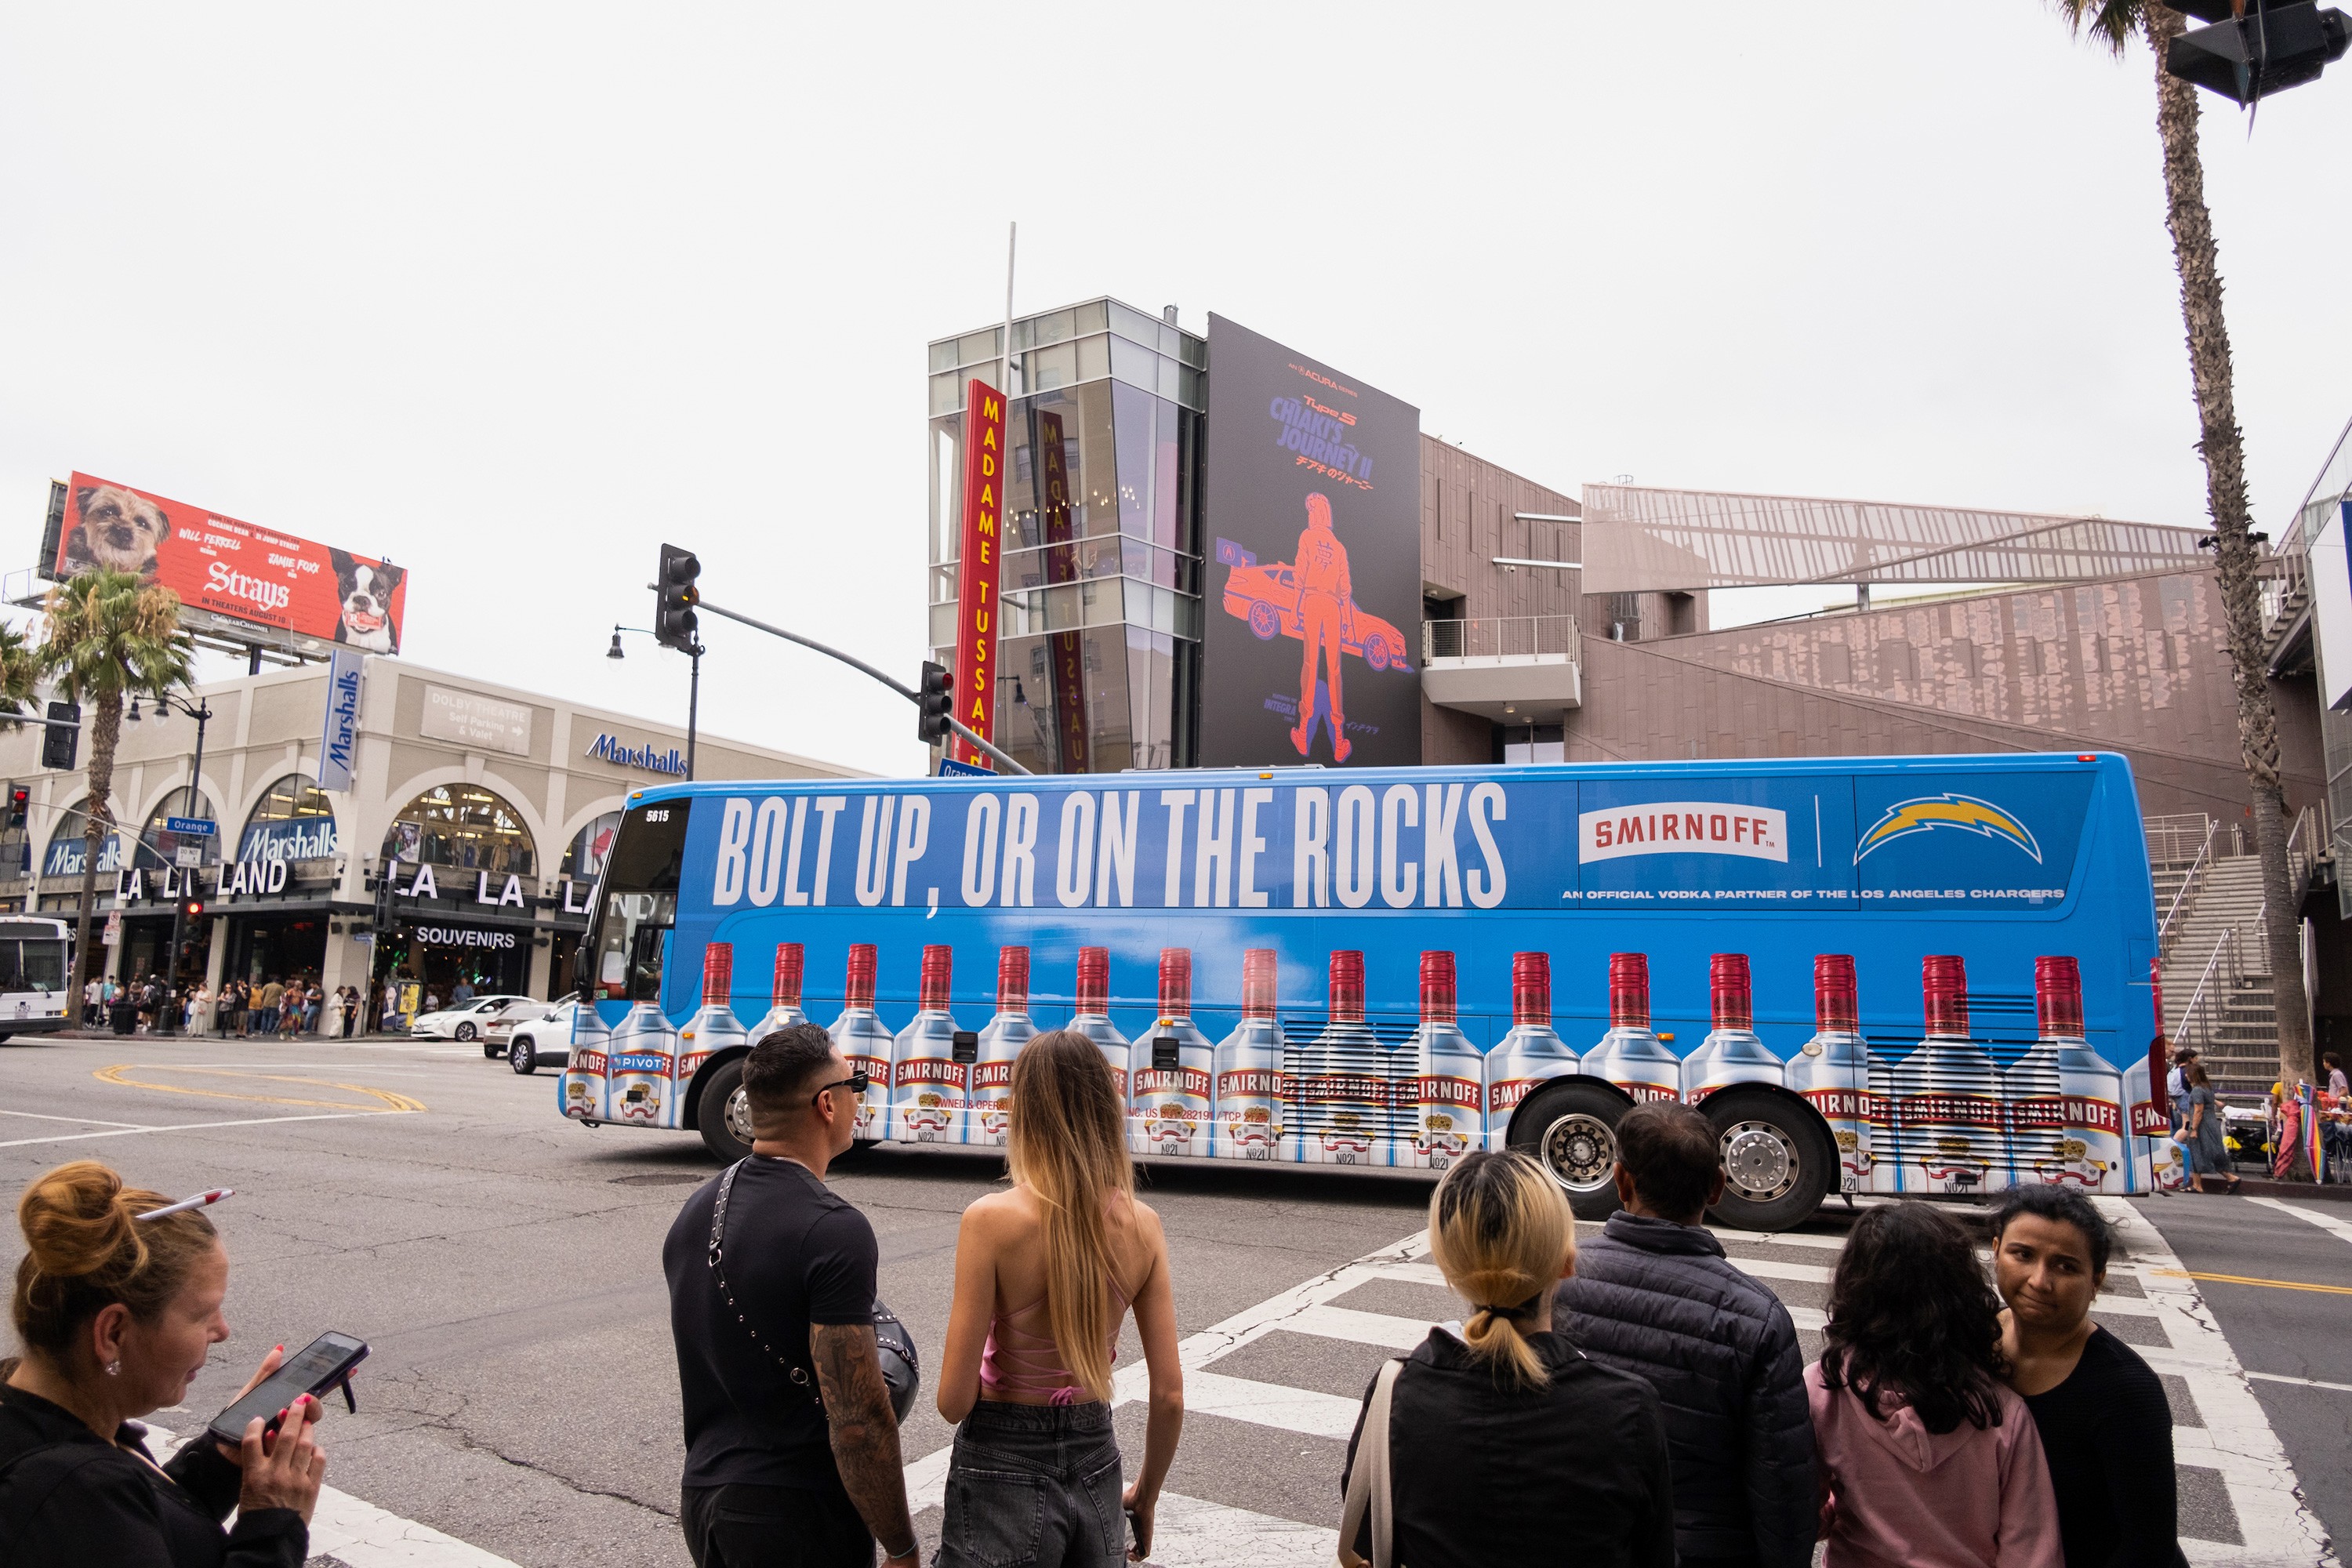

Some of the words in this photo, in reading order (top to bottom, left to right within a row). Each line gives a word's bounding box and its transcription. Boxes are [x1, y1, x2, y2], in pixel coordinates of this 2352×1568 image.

[1305, 369, 1338, 390] ACURA
[1269, 397, 1345, 444] CHIAKI'S
[1303, 394, 1339, 418] Type
[1338, 412, 1357, 426] S
[1276, 424, 1360, 474] JOURNEY
[1358, 456, 1374, 480] II
[978, 396, 999, 564] MADAME
[208, 519, 234, 533] COCAINE
[234, 526, 249, 537] BEAR
[263, 535, 278, 546] JUMP
[279, 539, 300, 551] STREET
[209, 514, 223, 522] FROM
[256, 525, 267, 534] WHO
[179, 528, 201, 543] WILL
[204, 533, 241, 551] FERRELL
[268, 553, 296, 568] JAMIE
[296, 558, 320, 575] FOXX
[203, 561, 291, 612] Strays
[201, 597, 210, 605] IN
[212, 599, 248, 615] THEATERS
[249, 608, 277, 623] AUGUST
[433, 693, 472, 711] DOLBY
[475, 702, 526, 723] THEATRE
[1264, 698, 1297, 717] INTEGRA
[330, 670, 358, 772] Marshalls
[449, 711, 468, 724] Self
[470, 717, 505, 735] Parking
[459, 725, 466, 736] &
[470, 727, 492, 741] Valet
[586, 733, 688, 775] Marshalls
[174, 820, 209, 833] Orange
[646, 810, 670, 822] 5615
[243, 822, 337, 862] Marshalls
[1595, 814, 1768, 848] SMIRNOFF
[48, 841, 121, 875] Marsalls
[713, 796, 846, 906] BOLT
[855, 794, 939, 920] UP,
[960, 790, 1039, 907] OR
[1055, 789, 1140, 908] ON
[1161, 787, 1273, 908] THE
[1294, 781, 1507, 909] ROCKS
[117, 868, 142, 900] LA
[216, 858, 287, 895] LAND
[388, 860, 438, 899] LA
[477, 871, 524, 908] LA
[1562, 891, 1583, 899] AN
[1586, 891, 1654, 899] OFFICIAL
[1658, 891, 1711, 899] VODKA
[1715, 891, 1788, 899] PARTNER
[1791, 890, 1813, 898] OF
[1816, 890, 1847, 898] THE
[1851, 890, 1884, 898] LOS
[1889, 890, 1966, 898] ANGELES
[1969, 889, 2065, 898] CHARGERS
[416, 926, 515, 949] SOUVENIRS
[622, 1058, 662, 1069] PIVOT
[898, 1062, 964, 1083] SMIRNOFF
[1137, 1071, 1208, 1093] SMIRNOFF
[968, 1099, 975, 1109] &
[1145, 1109, 1158, 1118] US
[1181, 1110, 1214, 1120] 282191
[1223, 1111, 1241, 1121] TCP
